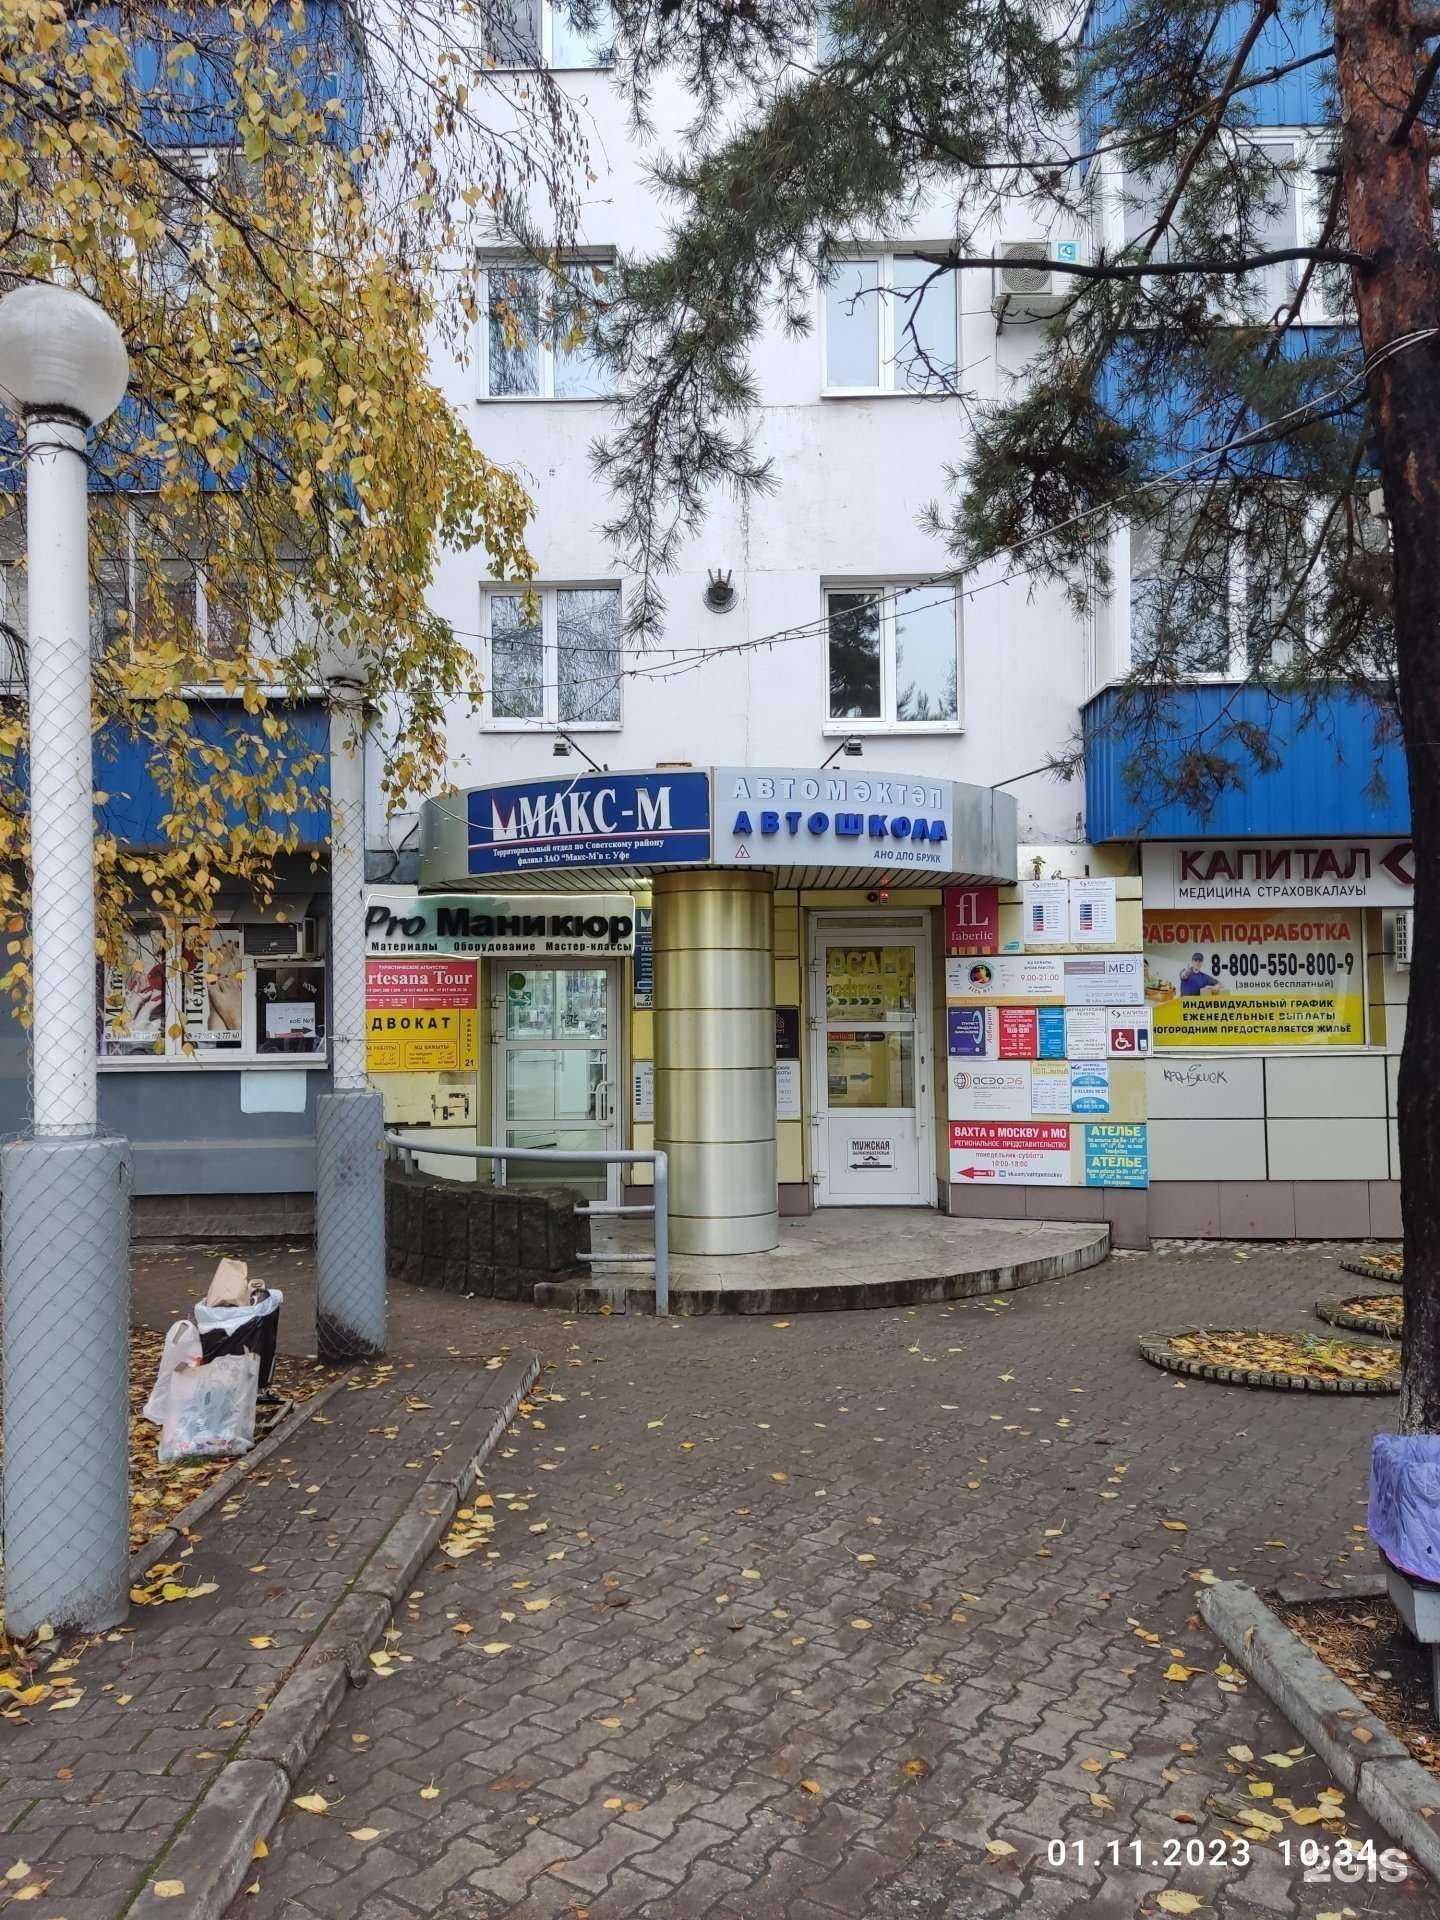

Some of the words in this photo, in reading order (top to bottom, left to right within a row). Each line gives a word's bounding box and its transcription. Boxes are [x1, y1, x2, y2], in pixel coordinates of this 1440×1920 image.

[733, 778, 943, 810] АВТОМӘКТӘП
[733, 810, 947, 841] АВТОШКОЛА
[493, 845, 551, 858] Территориальный
[553, 844, 572, 853] отдел
[574, 843, 583, 851] по
[586, 840, 632, 852] Советскому
[635, 838, 664, 850] району
[517, 856, 542, 866] филиал
[544, 854, 560, 863] ЗАО
[613, 850, 630, 861] Уфе
[873, 849, 893, 860] АНО
[895, 851, 914, 862] ДПО
[916, 853, 941, 864] БРУКК
[1178, 847, 1372, 881] КАПИТАЛ
[1178, 887, 1251, 900] МЕДИЦИНА
[1258, 885, 1367, 898] СТРАХОВКАЛАУЫ
[364, 905, 426, 938] Pro
[436, 907, 633, 944] Маникюр
[951, 930, 993, 941] faberlic
[1221, 922, 1351, 945] ПОДРАБОТКА
[370, 941, 438, 952] Материалы
[453, 941, 536, 953] Оборудование
[545, 941, 631, 952] Мастер-классы
[1108, 963, 1134, 973] MED
[1211, 952, 1354, 977] 8-800-550-800-9
[365, 972, 429, 985] rtesana
[434, 970, 473, 985] Tour
[1235, 979, 1271, 989] (звонок
[1273, 978, 1334, 990] бесплатный)
[1183, 998, 1287, 1010] ИНДИВИДУАЛЬНЫЙ
[1291, 1000, 1333, 1009] ГРАФИК
[1183, 1012, 1274, 1023] ЕЖЕНЕДЕЛЬНЫЕ
[1279, 1012, 1335, 1022] ВЫПЛАТЫ
[365, 1017, 451, 1032] ДВОКАТ
[1221, 1025, 1314, 1035] ПРЕДОСТАВЛЯЕТСЯ
[464, 1058, 474, 1067] 21
[954, 1127, 987, 1137] ВАХТА
[989, 1129, 996, 1137] в
[997, 1127, 1039, 1138] МОСКВУ
[1042, 1130, 1048, 1138] и
[1051, 1128, 1067, 1138] МО
[1091, 1125, 1141, 1137] АТЕЛЬЕ
[851, 1140, 890, 1151] МУЖСКАЯ
[954, 1139, 1000, 1147] РЕГИОНАЛЬНОЕ
[1002, 1140, 1067, 1149] ПРЕДСТАВИТЕЛЬСТВО
[1092, 1157, 1142, 1168] АТЕЛЬЕ
